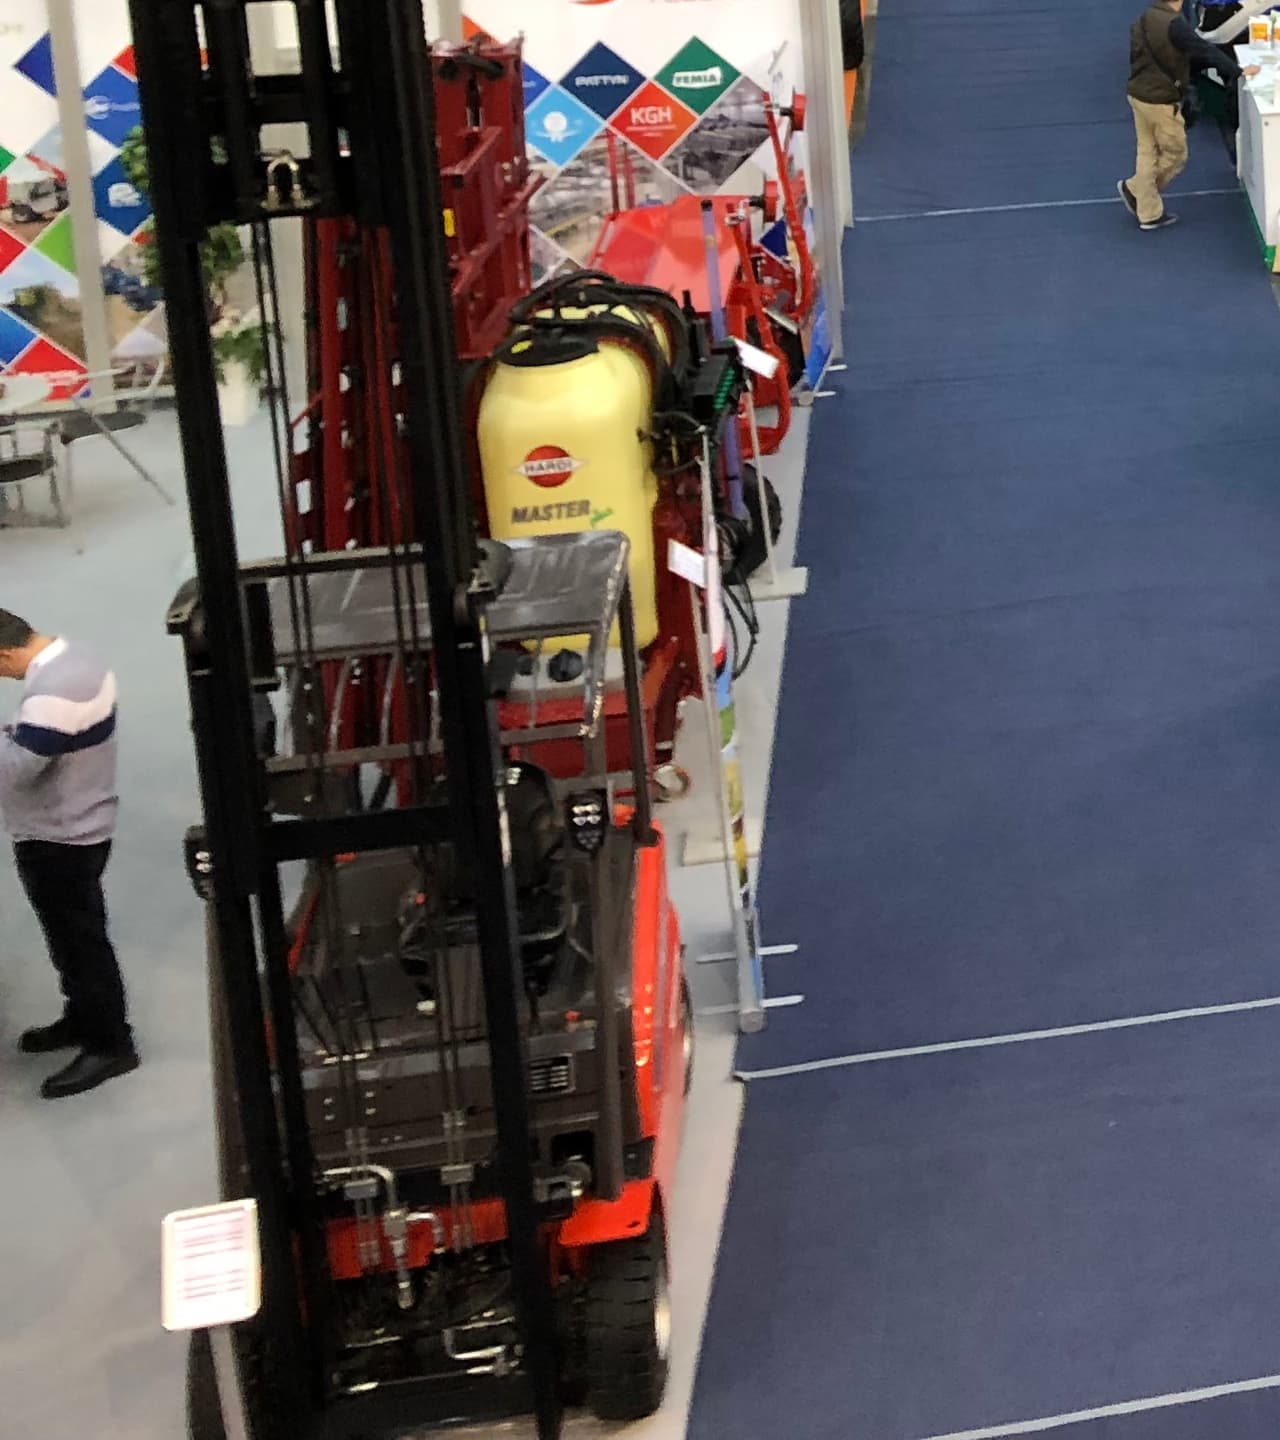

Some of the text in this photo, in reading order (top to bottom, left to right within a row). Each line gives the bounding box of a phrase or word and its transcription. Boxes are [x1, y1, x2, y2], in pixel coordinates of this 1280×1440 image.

[630, 106, 672, 126] KGH
[524, 459, 572, 474] HARDI
[511, 499, 591, 524] MASTER
